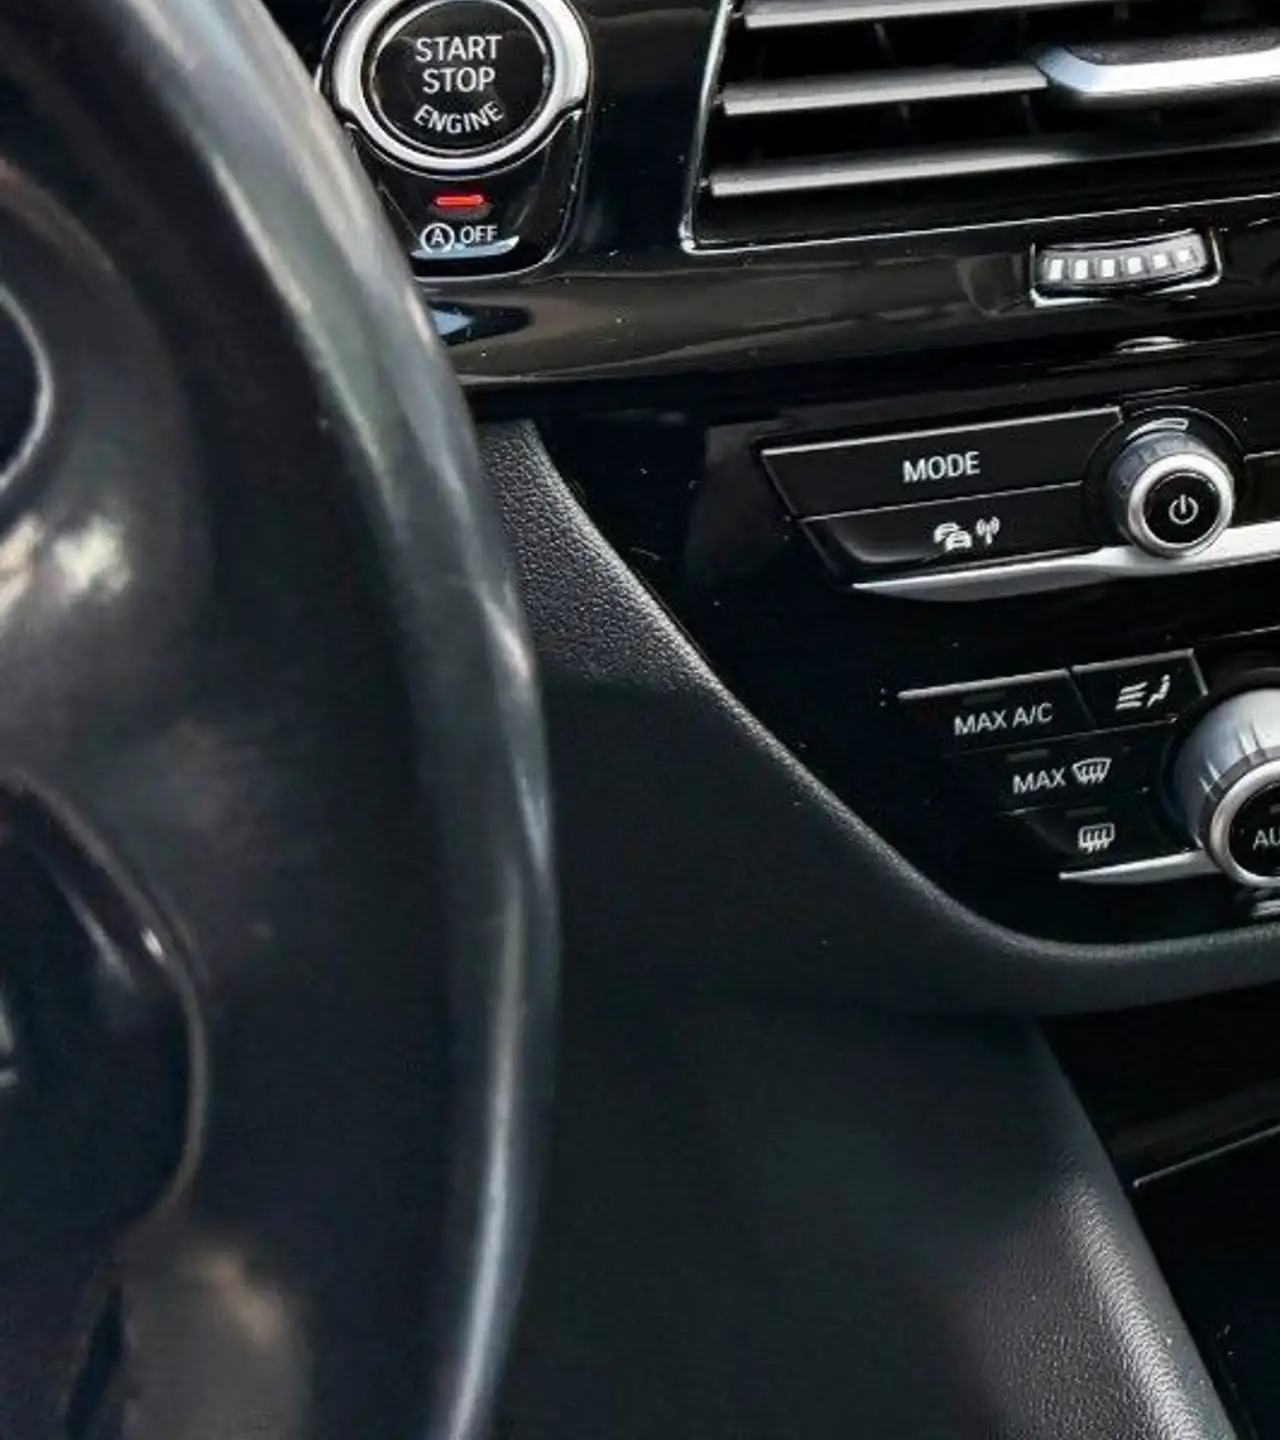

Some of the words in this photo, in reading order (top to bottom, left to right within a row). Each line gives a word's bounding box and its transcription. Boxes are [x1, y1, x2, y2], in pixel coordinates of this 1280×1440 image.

[415, 35, 503, 62] START
[421, 66, 496, 95] STOP
[412, 100, 505, 136] ENGINE
[459, 224, 499, 244] OFF
[902, 450, 982, 484] MODE
[952, 709, 1007, 738] MAX
[1011, 701, 1054, 727] A/C
[1011, 768, 1067, 795] MAX
